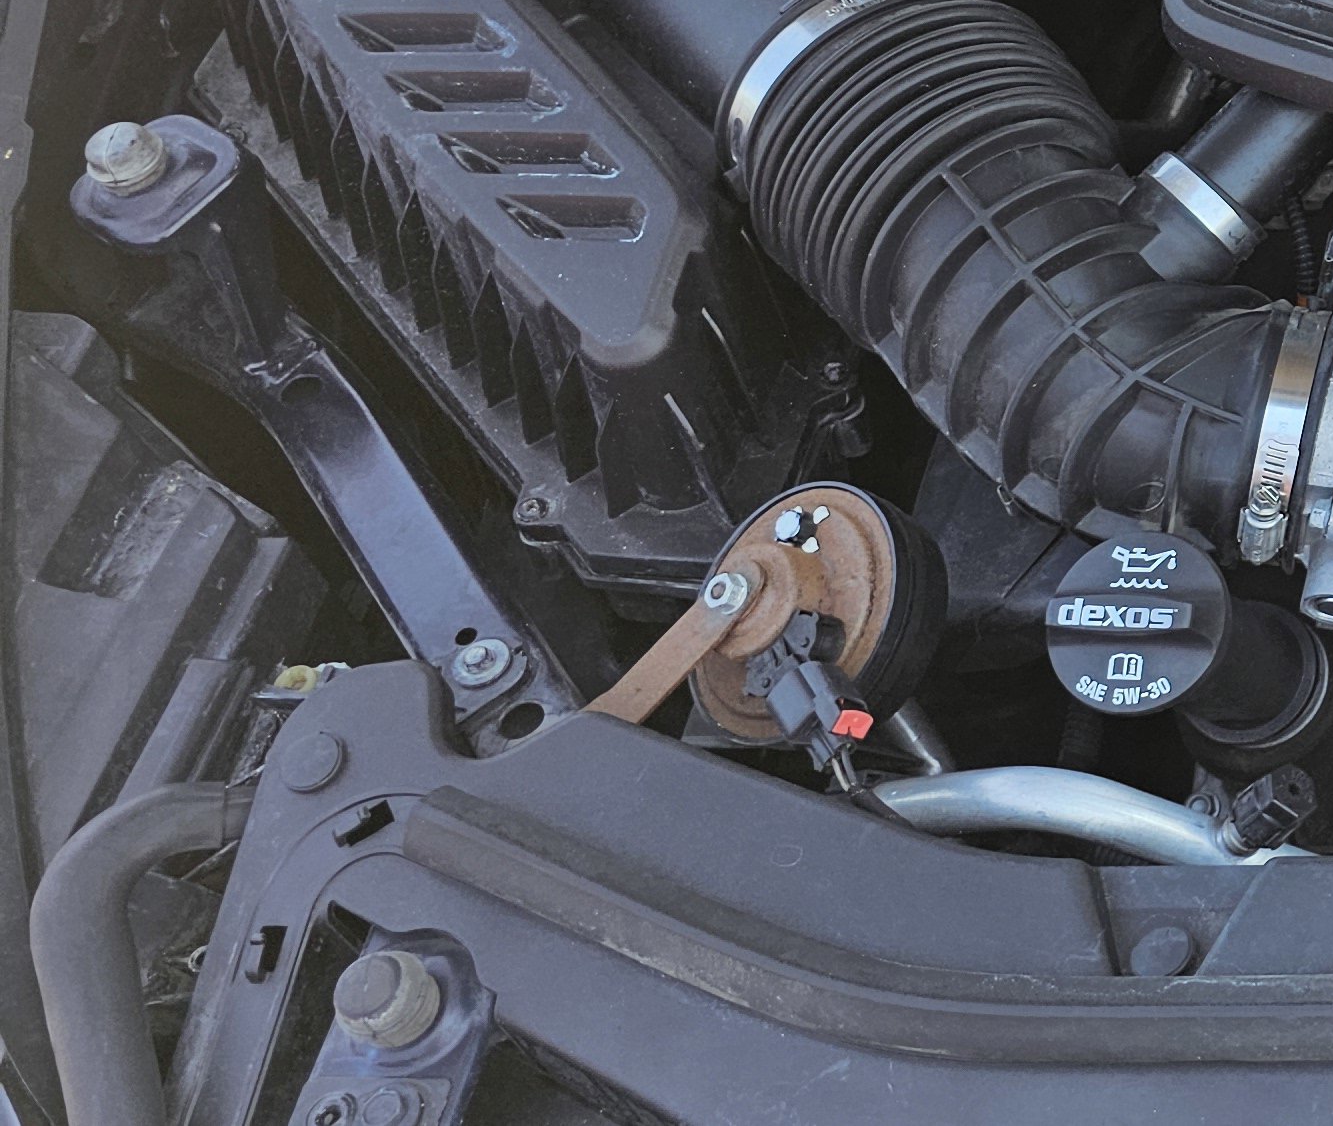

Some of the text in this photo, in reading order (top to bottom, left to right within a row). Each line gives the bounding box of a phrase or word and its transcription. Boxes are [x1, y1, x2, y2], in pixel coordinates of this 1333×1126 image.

[1057, 597, 1175, 630] dexos
[1075, 675, 1172, 705] SAE 5W-30
